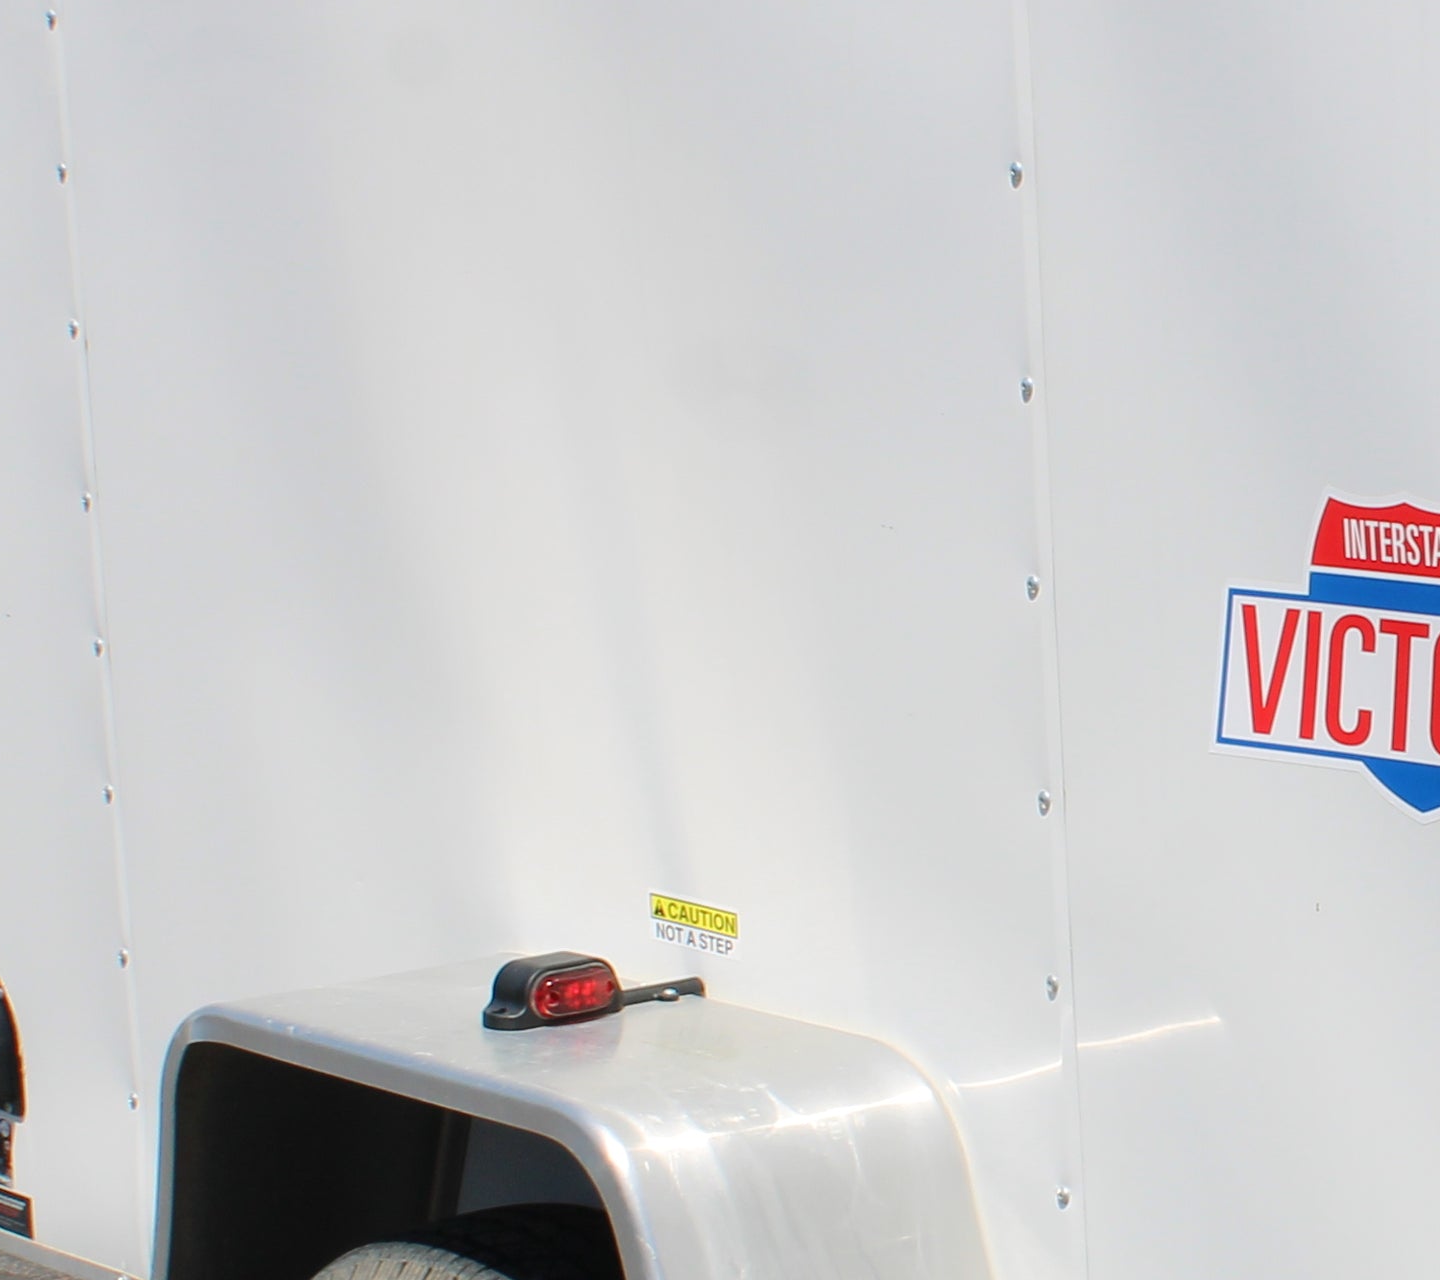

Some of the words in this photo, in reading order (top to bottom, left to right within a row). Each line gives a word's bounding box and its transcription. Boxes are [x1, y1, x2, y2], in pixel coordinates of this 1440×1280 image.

[667, 902, 736, 934] CAUTION
[656, 922, 684, 943] NOT
[686, 930, 697, 947] A
[699, 933, 734, 955] STEP
